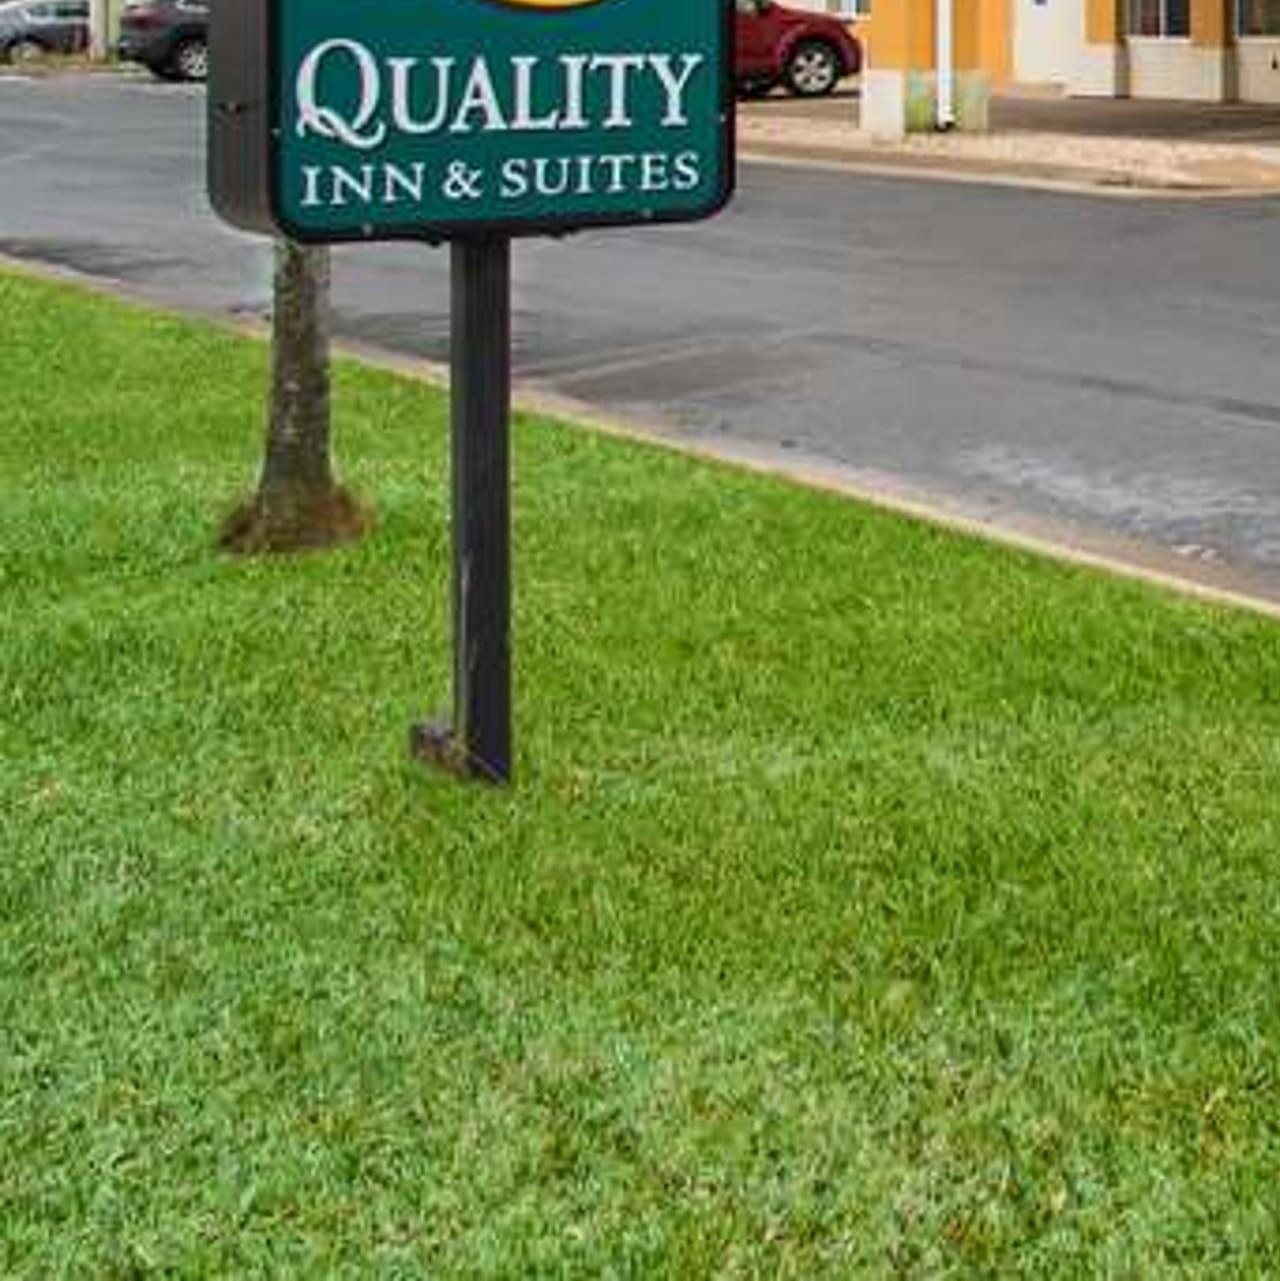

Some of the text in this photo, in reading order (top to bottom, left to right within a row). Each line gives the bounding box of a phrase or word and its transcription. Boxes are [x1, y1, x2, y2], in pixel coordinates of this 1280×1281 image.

[296, 38, 703, 148] QUALITY
[300, 151, 699, 205] INN & SUITES
